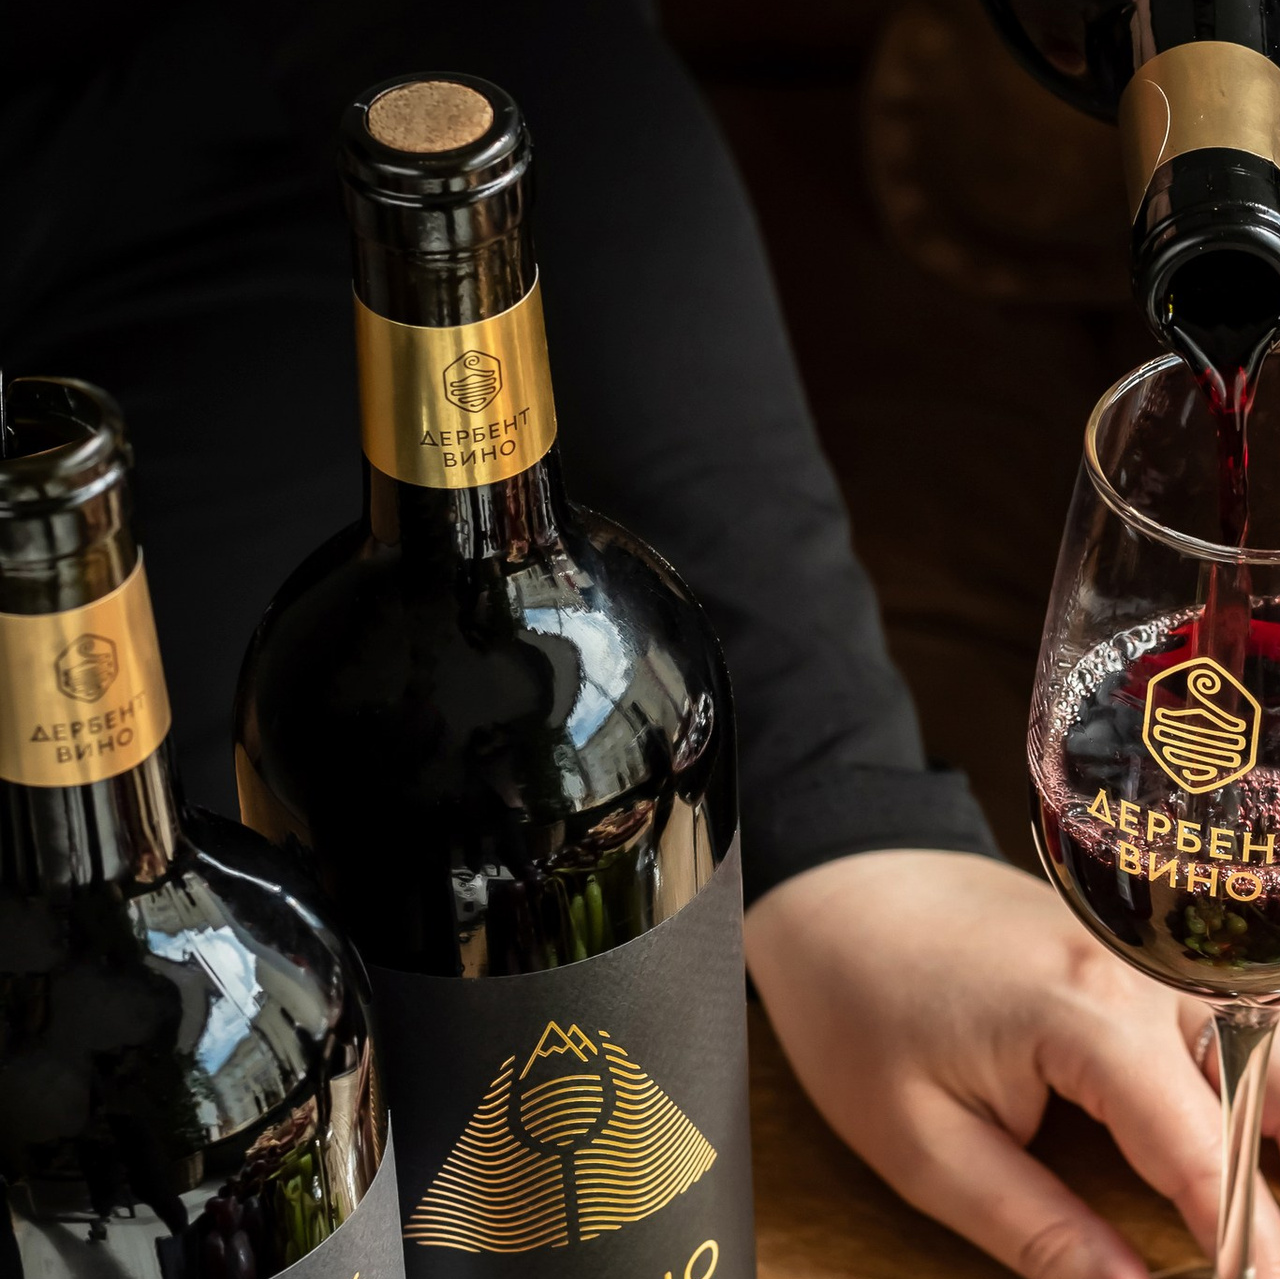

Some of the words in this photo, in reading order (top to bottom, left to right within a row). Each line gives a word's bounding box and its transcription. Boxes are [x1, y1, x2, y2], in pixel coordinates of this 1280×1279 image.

[419, 406, 530, 447] ДЕРБЕНТ
[442, 439, 516, 468] ВИНО
[29, 689, 147, 743] ДЕРБЕНТ
[56, 726, 135, 764] ВИНО
[1117, 840, 1264, 903] ВИНО
